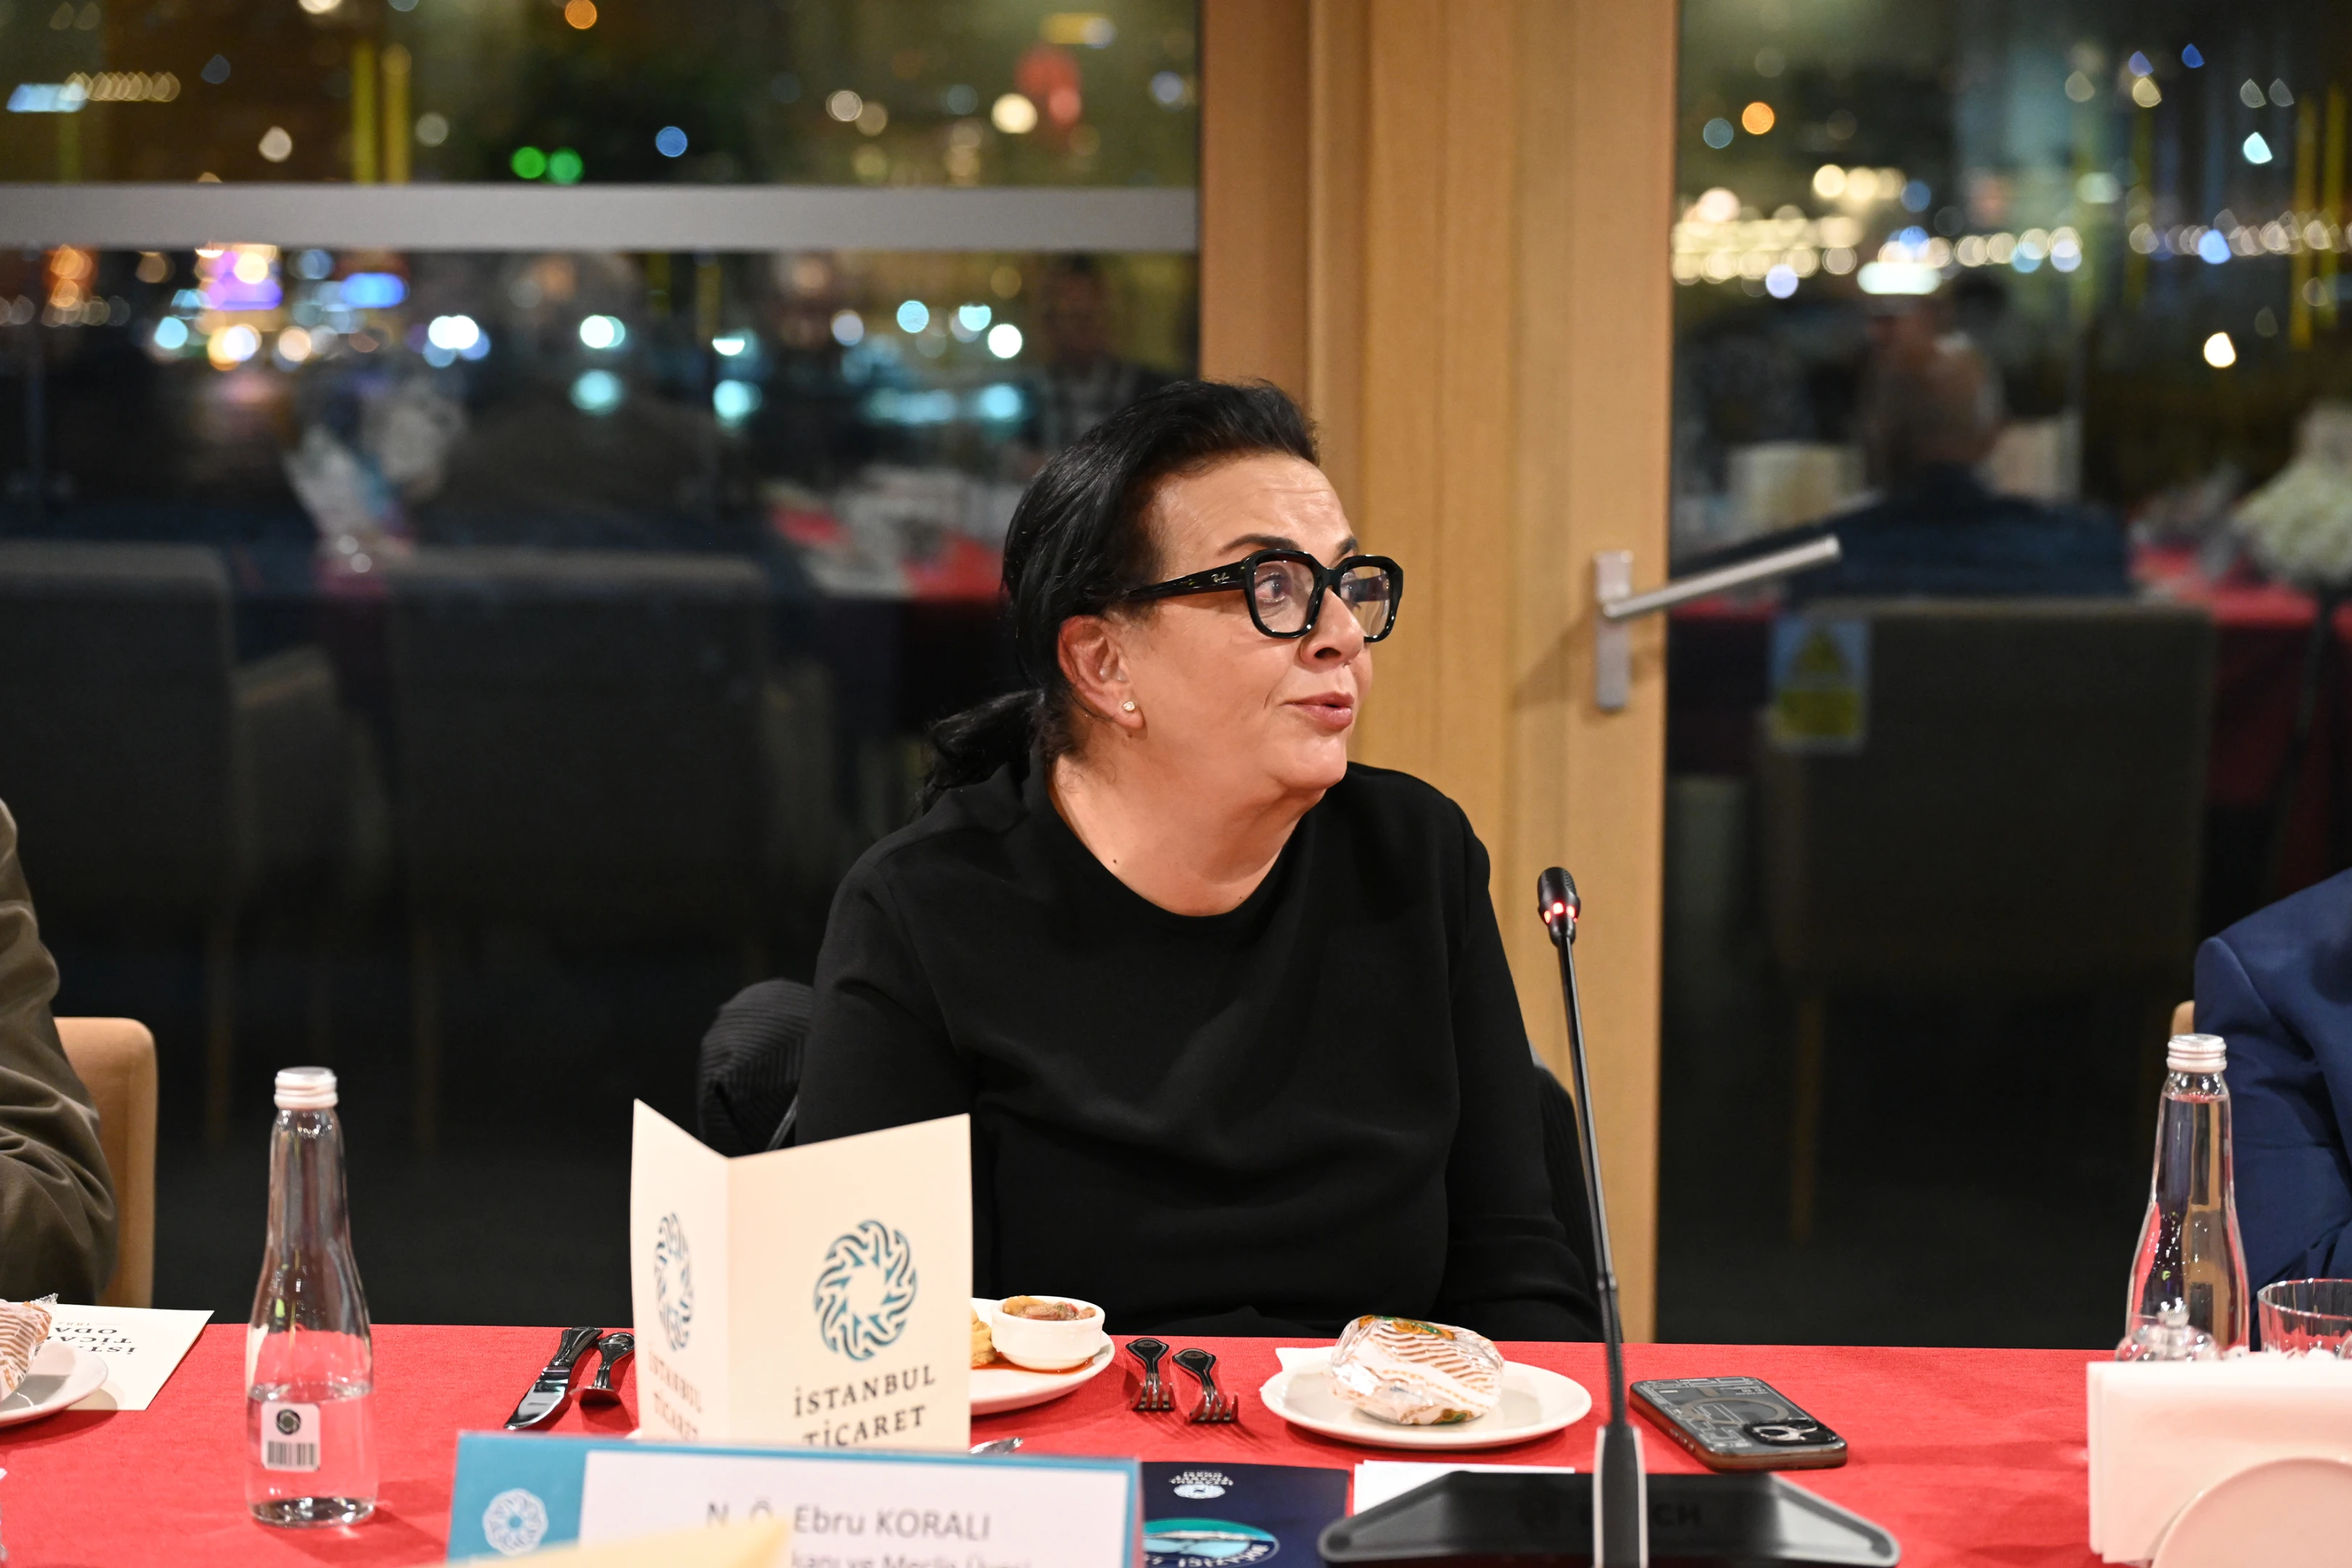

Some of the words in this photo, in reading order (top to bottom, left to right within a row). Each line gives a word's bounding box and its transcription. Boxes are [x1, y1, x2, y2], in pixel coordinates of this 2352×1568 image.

[793, 1364, 936, 1417] İSTANBUL
[802, 1404, 926, 1448] TİCARET
[793, 1503, 865, 1536] Ebru
[875, 1507, 992, 1542] KORALI
